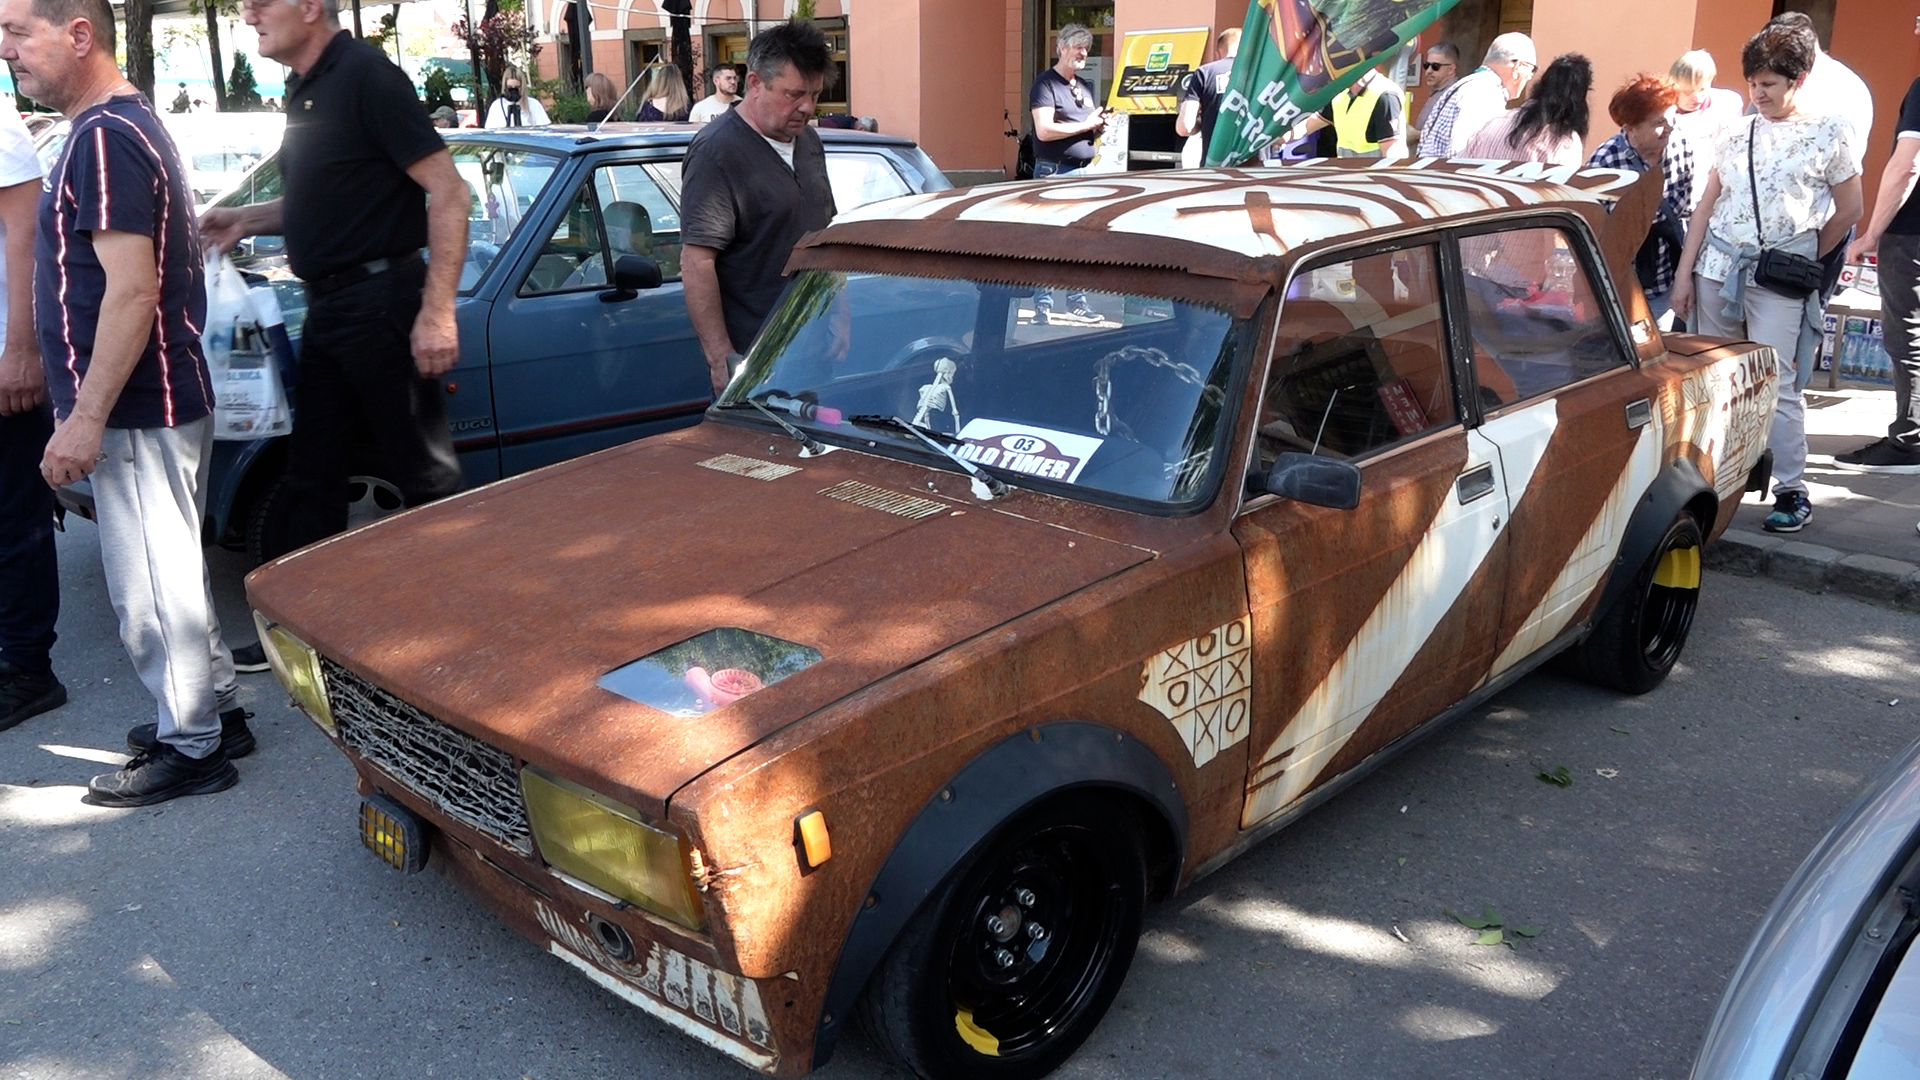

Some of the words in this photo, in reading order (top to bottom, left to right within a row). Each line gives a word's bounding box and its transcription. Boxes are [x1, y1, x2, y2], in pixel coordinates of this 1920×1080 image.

[1123, 74, 1179, 91] EXPERT
[1013, 438, 1035, 452] 03
[955, 443, 1001, 466] OLD
[998, 450, 1071, 479] TIMER
